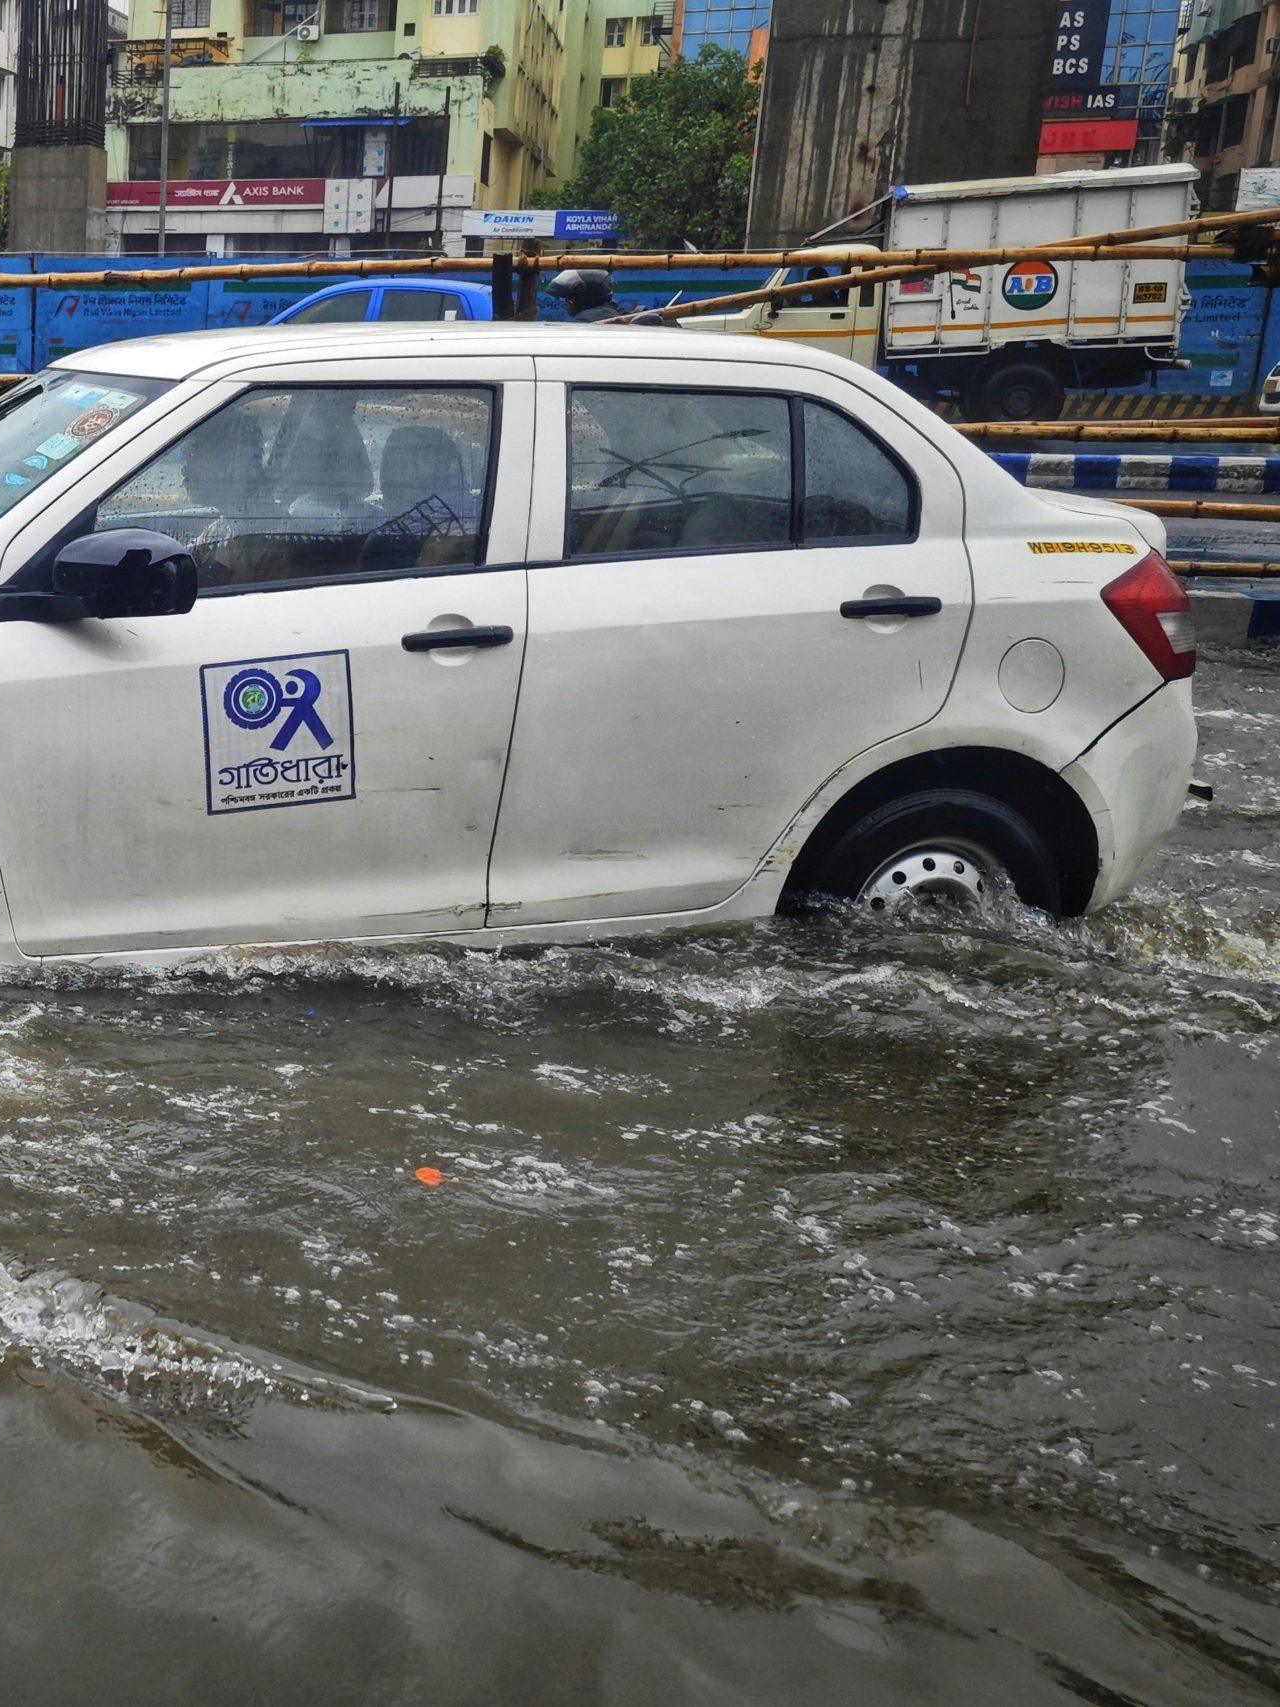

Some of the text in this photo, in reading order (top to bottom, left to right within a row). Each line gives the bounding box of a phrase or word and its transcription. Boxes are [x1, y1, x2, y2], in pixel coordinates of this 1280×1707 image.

[1086, 94, 1116, 108] IAS
[243, 186, 305, 196] AXIS BANK
[566, 214, 618, 223] KOYLA VIHAR
[218, 754, 344, 790] গতিধারা
[221, 783, 342, 806] পশ্চিমবঙ্গ সরকারের একটি প্রকল্প
